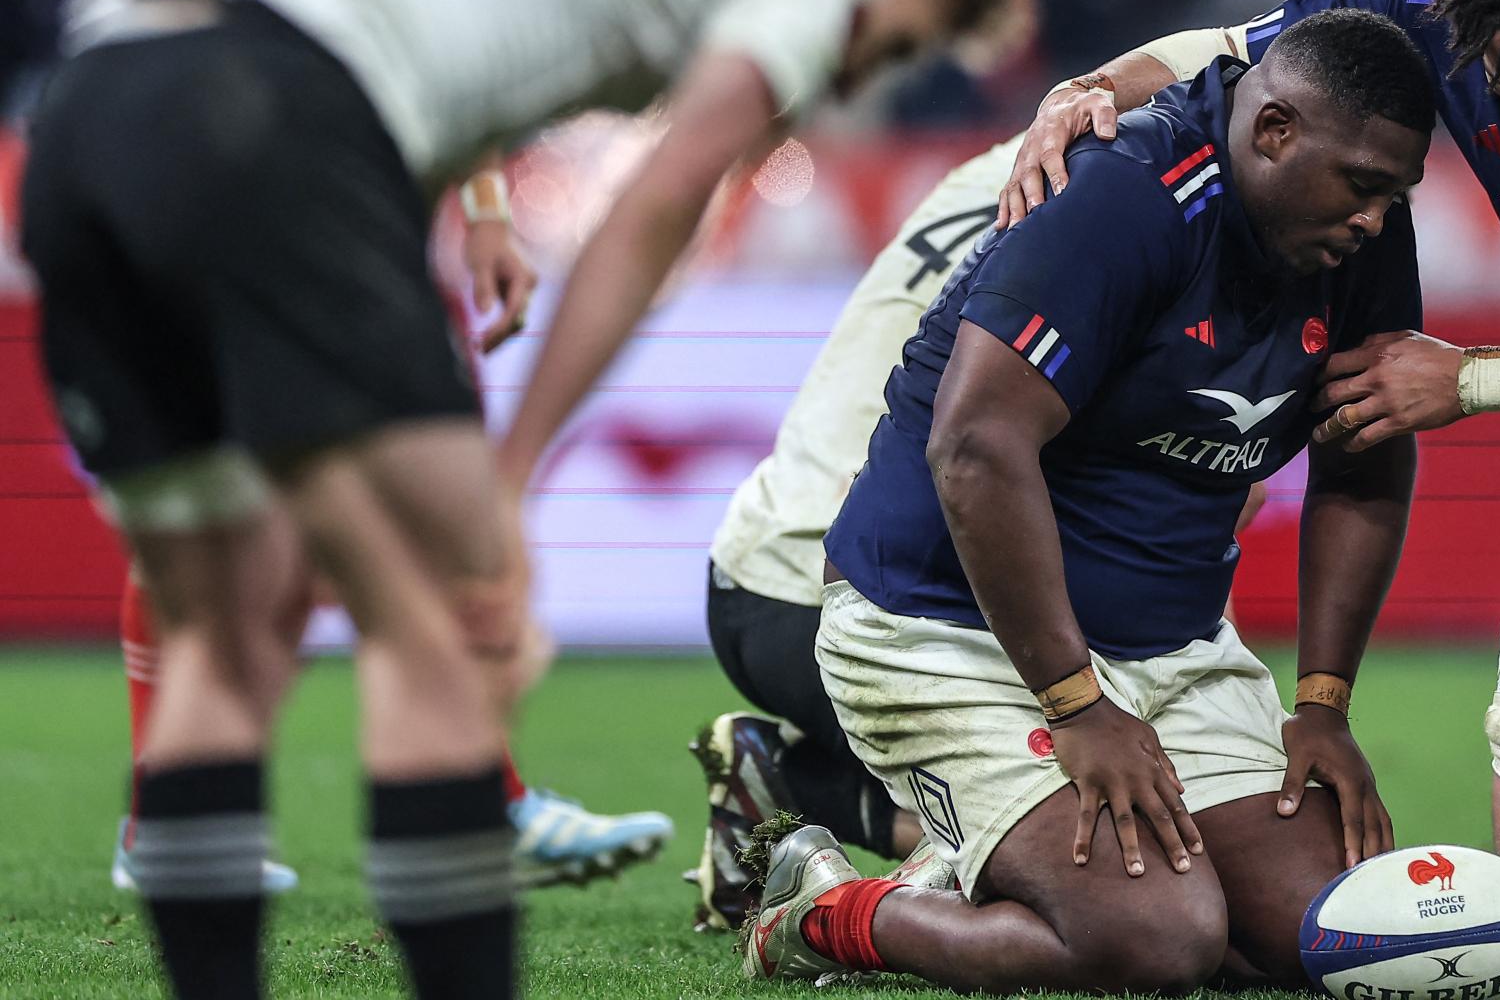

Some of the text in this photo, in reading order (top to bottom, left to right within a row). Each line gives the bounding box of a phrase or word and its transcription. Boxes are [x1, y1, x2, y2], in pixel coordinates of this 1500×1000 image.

[905, 204, 1000, 291] 4
[1136, 431, 1270, 473] ALTRAD
[1416, 895, 1465, 909] FRANCE
[1419, 904, 1465, 919] RUGBY
